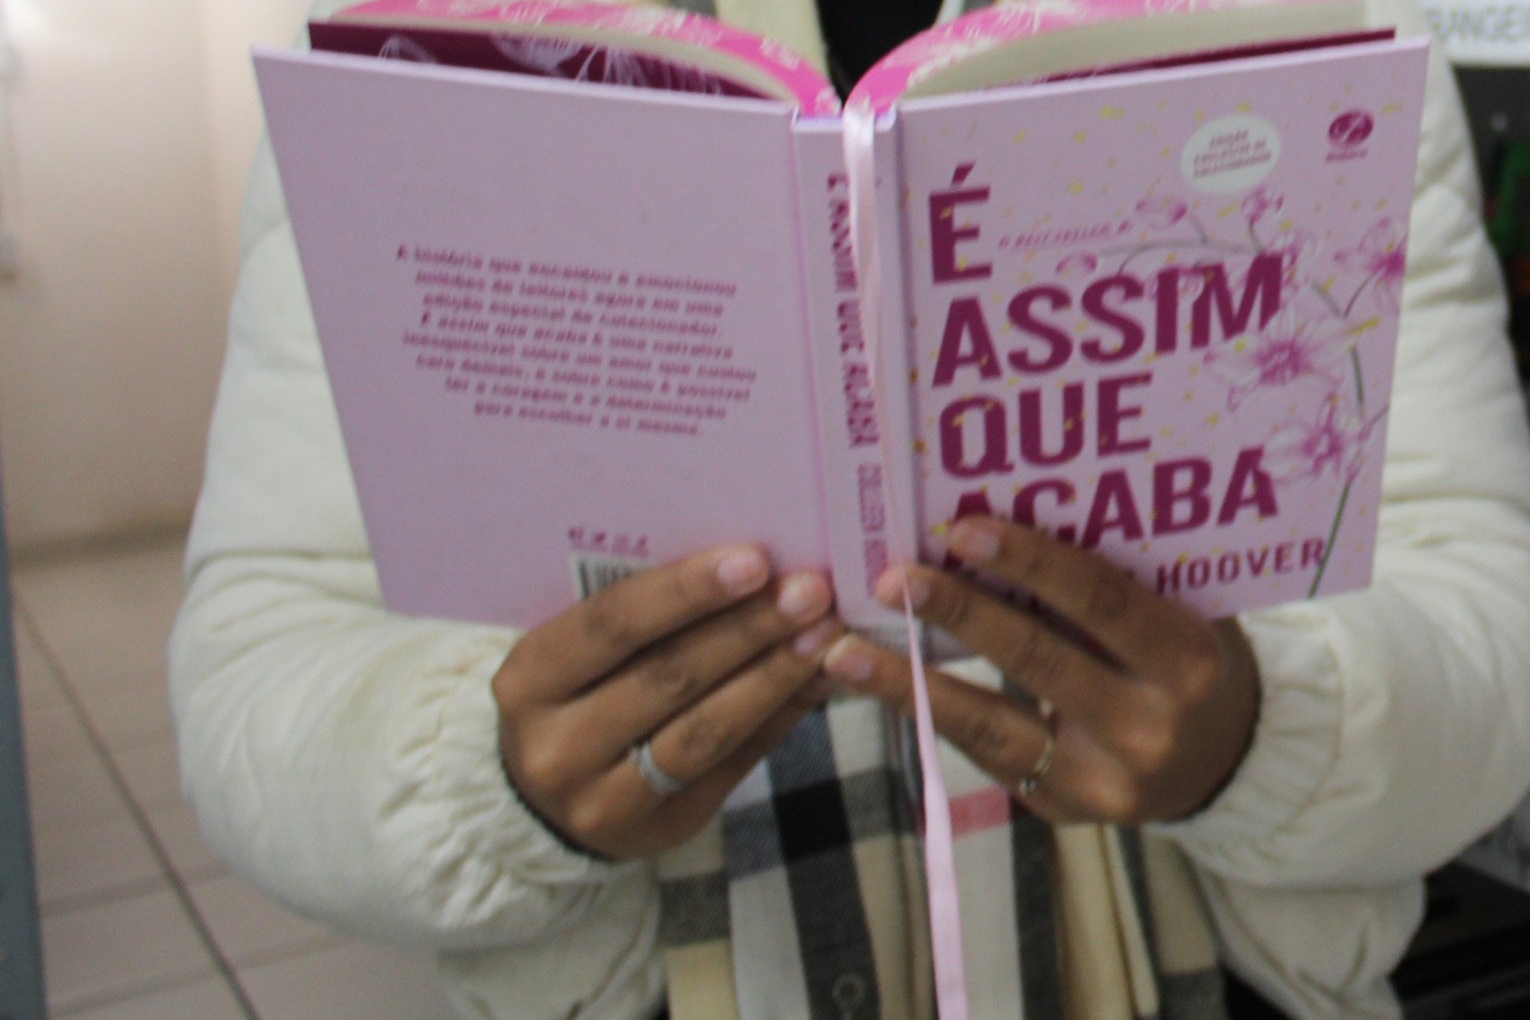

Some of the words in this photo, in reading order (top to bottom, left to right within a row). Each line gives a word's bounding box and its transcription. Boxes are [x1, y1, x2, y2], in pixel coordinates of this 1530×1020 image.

[928, 161, 992, 286] É
[932, 252, 1285, 389] ASSIM
[938, 372, 1153, 480] QUE
[1156, 537, 1326, 599] HOOVER
